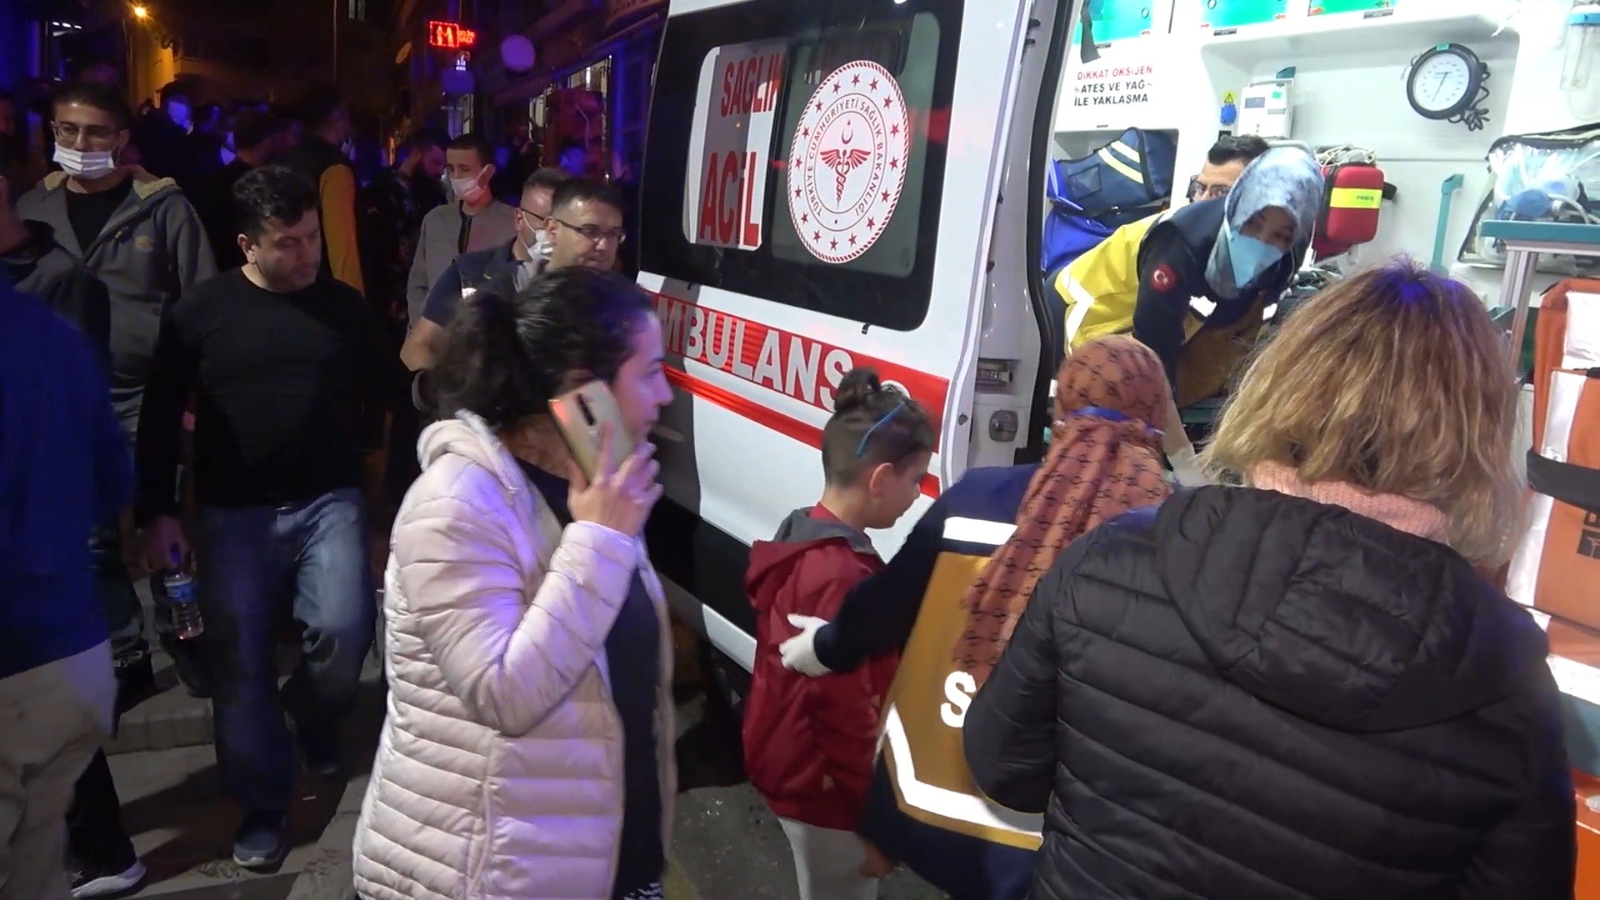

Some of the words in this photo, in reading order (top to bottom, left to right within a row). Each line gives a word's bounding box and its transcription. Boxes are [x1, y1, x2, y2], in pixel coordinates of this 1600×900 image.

[1092, 93, 1148, 105] YAKLAŞMA
[1109, 81, 1121, 92] VE
[860, 101, 882, 139] SAĞLIK
[656, 296, 854, 412] MBULANS
